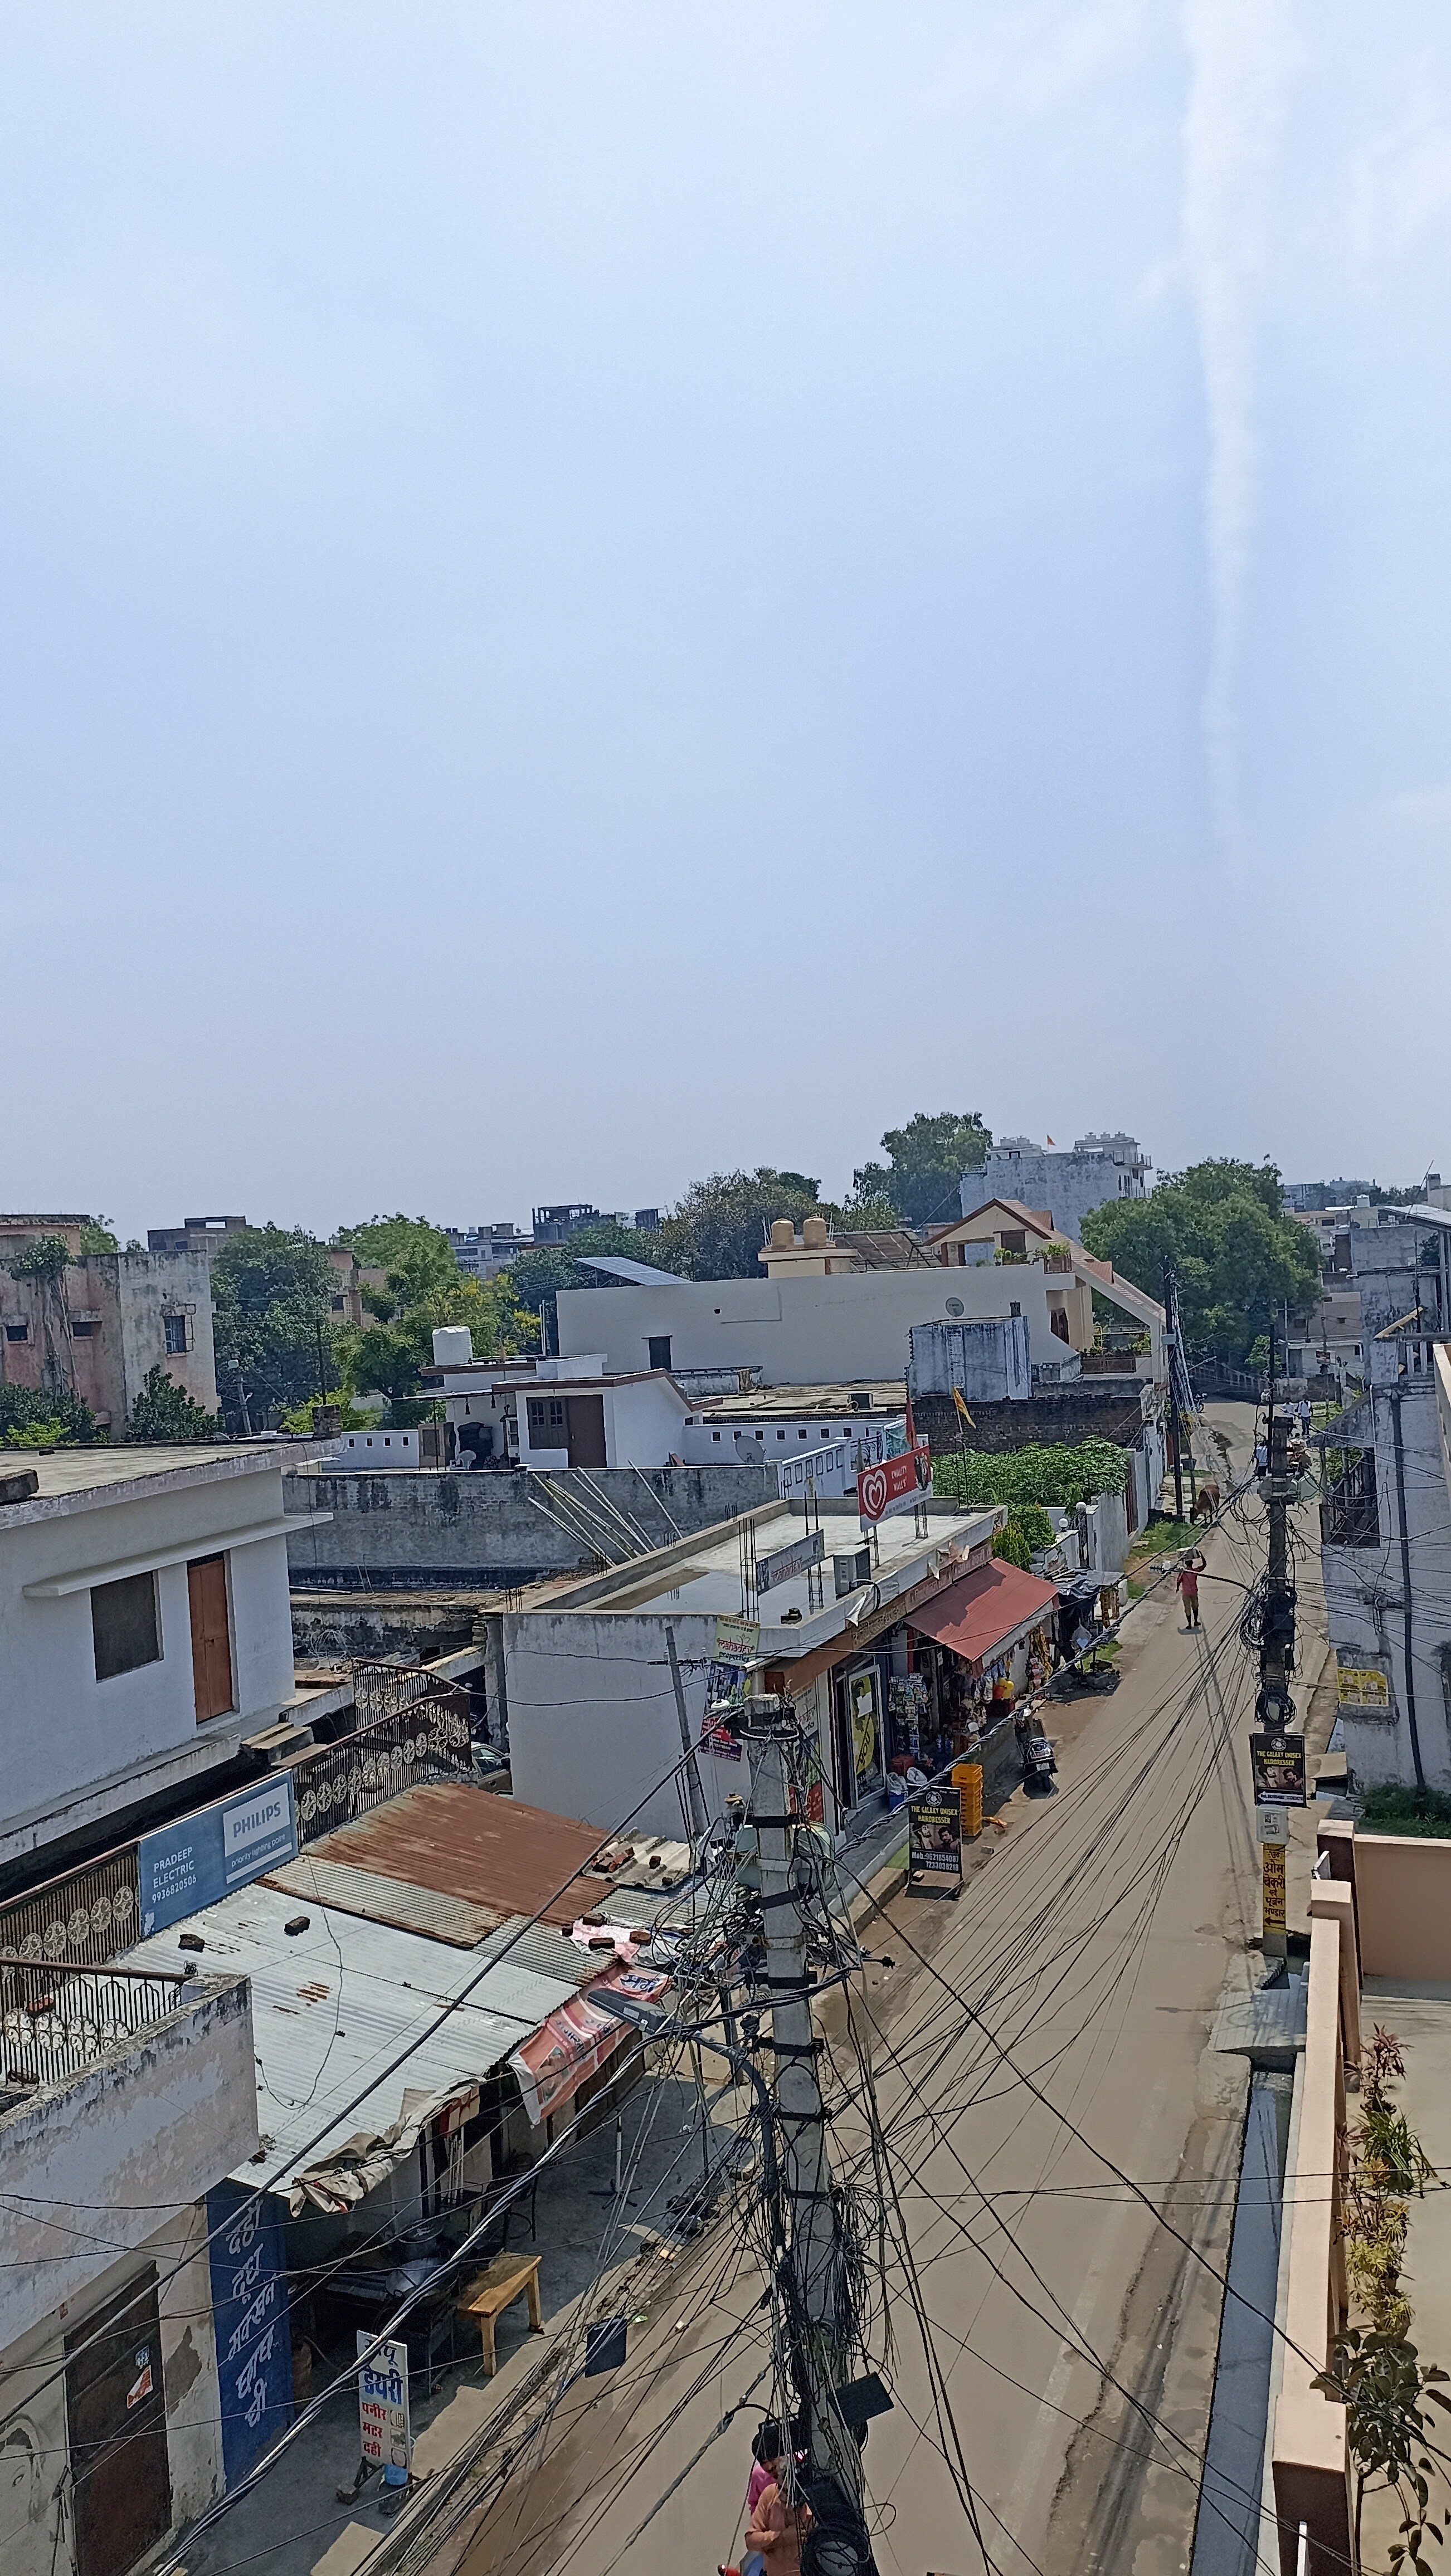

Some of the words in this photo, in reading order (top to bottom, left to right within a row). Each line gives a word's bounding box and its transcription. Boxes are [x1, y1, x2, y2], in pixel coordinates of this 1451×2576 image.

[233, 1801, 281, 1838] PHILIPS
[918, 1815, 951, 1824] HAIRDRESSER
[154, 1846, 193, 1873] PRADEEP
[231, 1852, 251, 1868] priority
[252, 1841, 271, 1857] lighting
[271, 1833, 285, 1848] point
[153, 1860, 194, 1889] ELECTRIC
[152, 1875, 197, 1904] 9936820506
[362, 2402, 387, 2421] पनीर
[362, 2421, 383, 2438] मटर
[363, 2441, 381, 2457] दही
